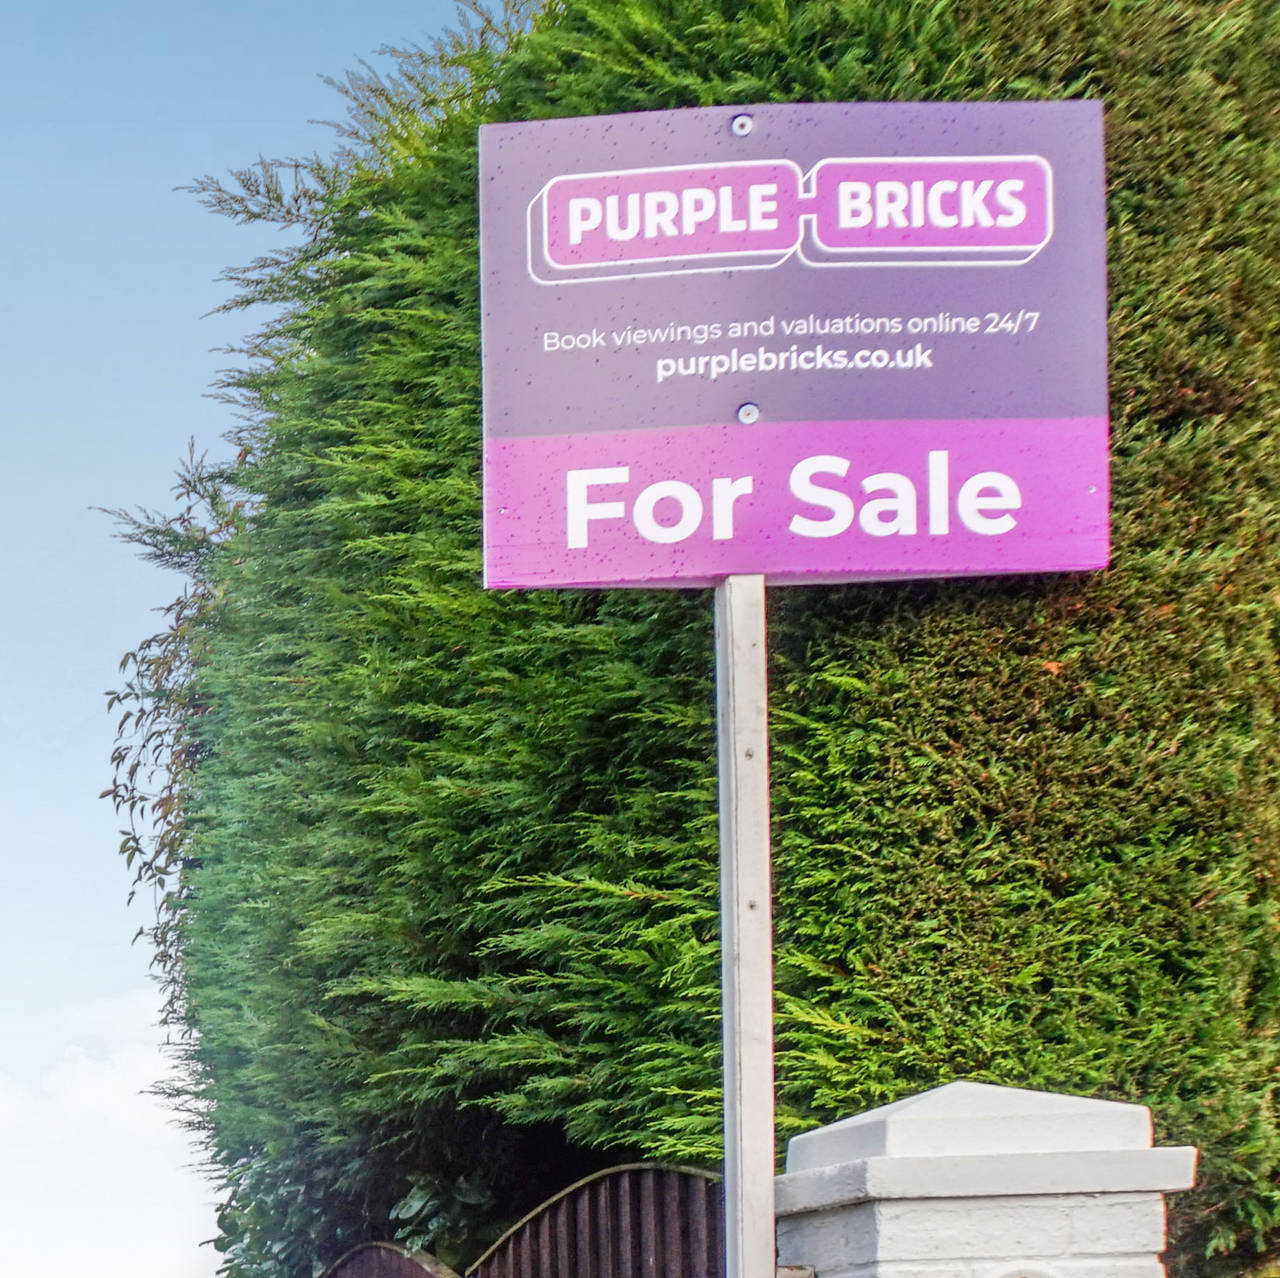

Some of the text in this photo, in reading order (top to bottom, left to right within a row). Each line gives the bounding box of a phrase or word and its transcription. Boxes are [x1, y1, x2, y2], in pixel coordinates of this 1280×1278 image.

[569, 179, 1027, 245] PURPLE BRICKS
[543, 309, 1040, 351] Book viewings and valuations online 24/7
[657, 343, 933, 383] purplebricks.co.uk
[567, 450, 1022, 549] For Sale
